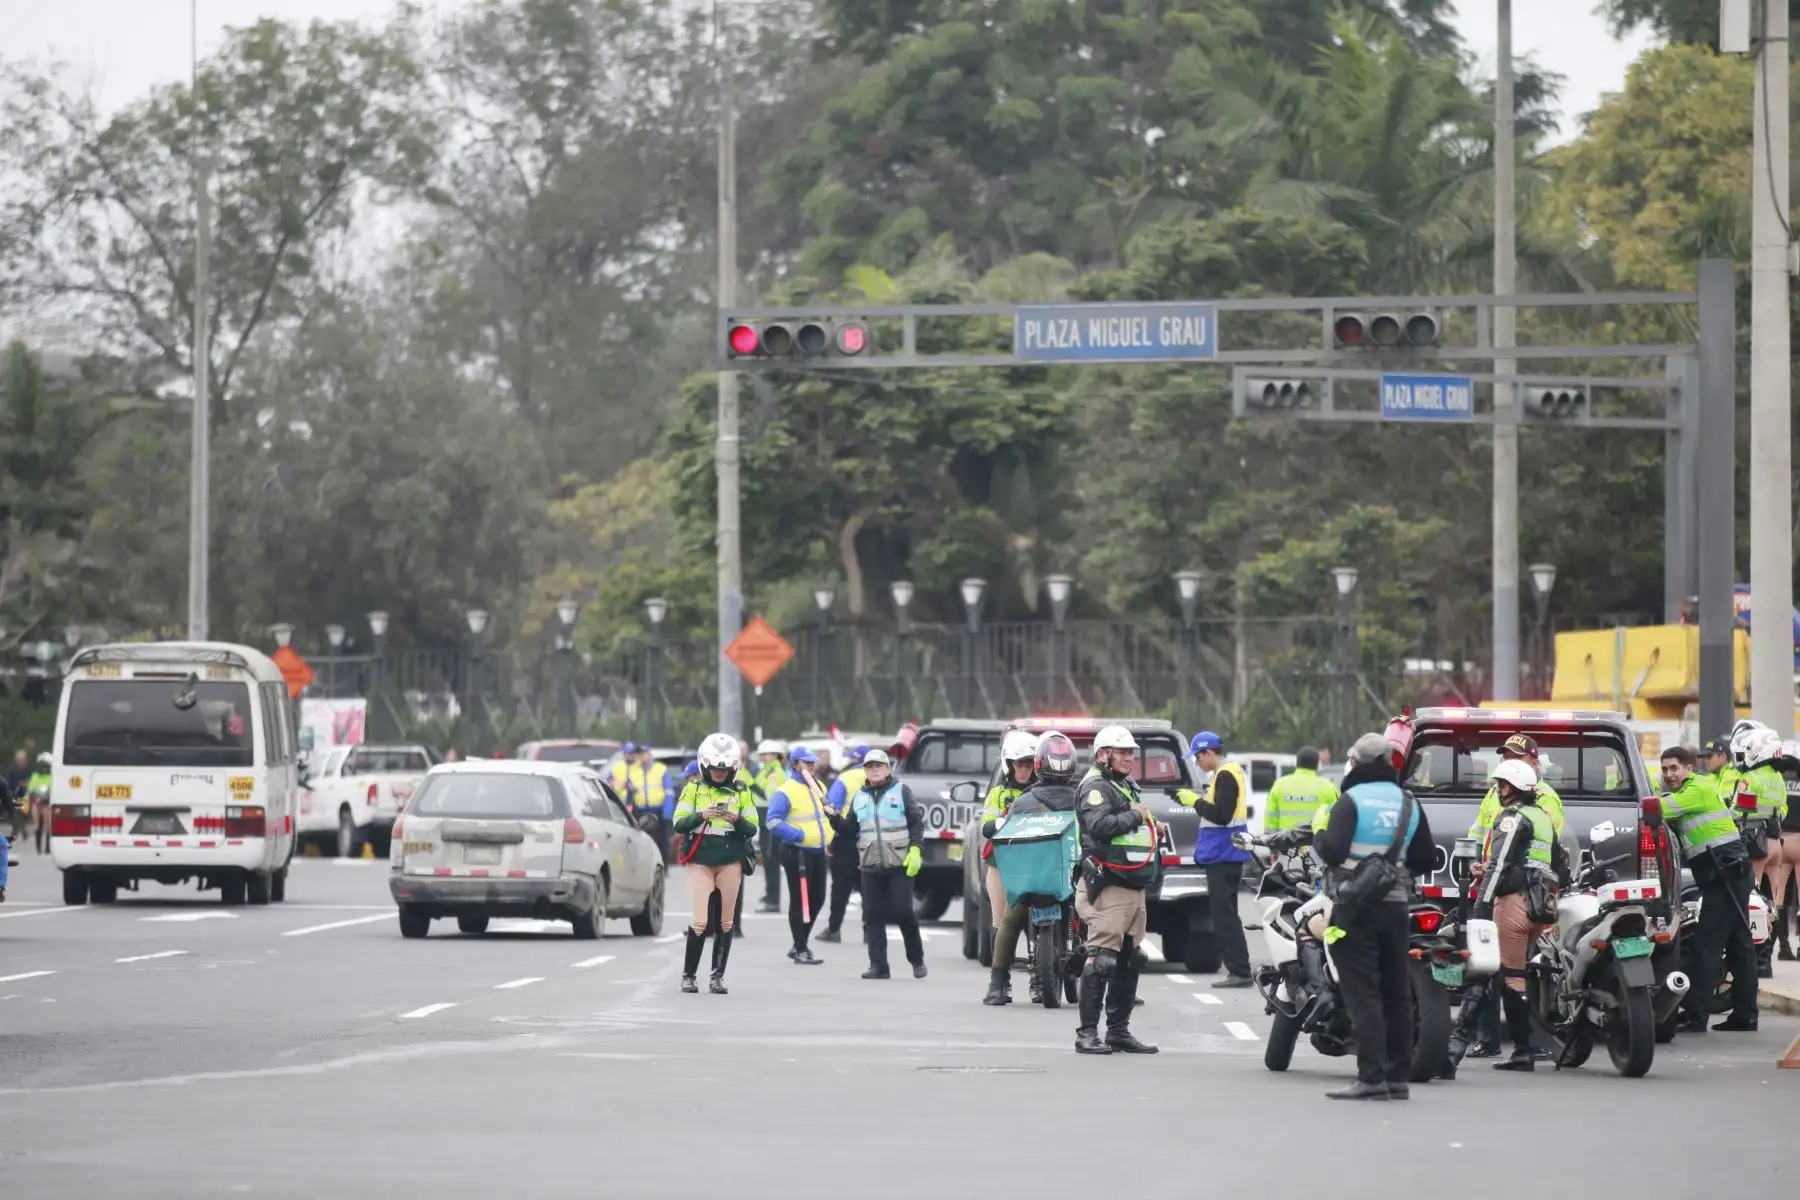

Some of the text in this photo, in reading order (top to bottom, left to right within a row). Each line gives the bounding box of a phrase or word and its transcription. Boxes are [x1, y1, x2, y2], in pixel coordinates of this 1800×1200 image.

[1024, 316, 1206, 349] PLAZA MIGUEL GRAU
[1384, 383, 1412, 409] PLAZA
